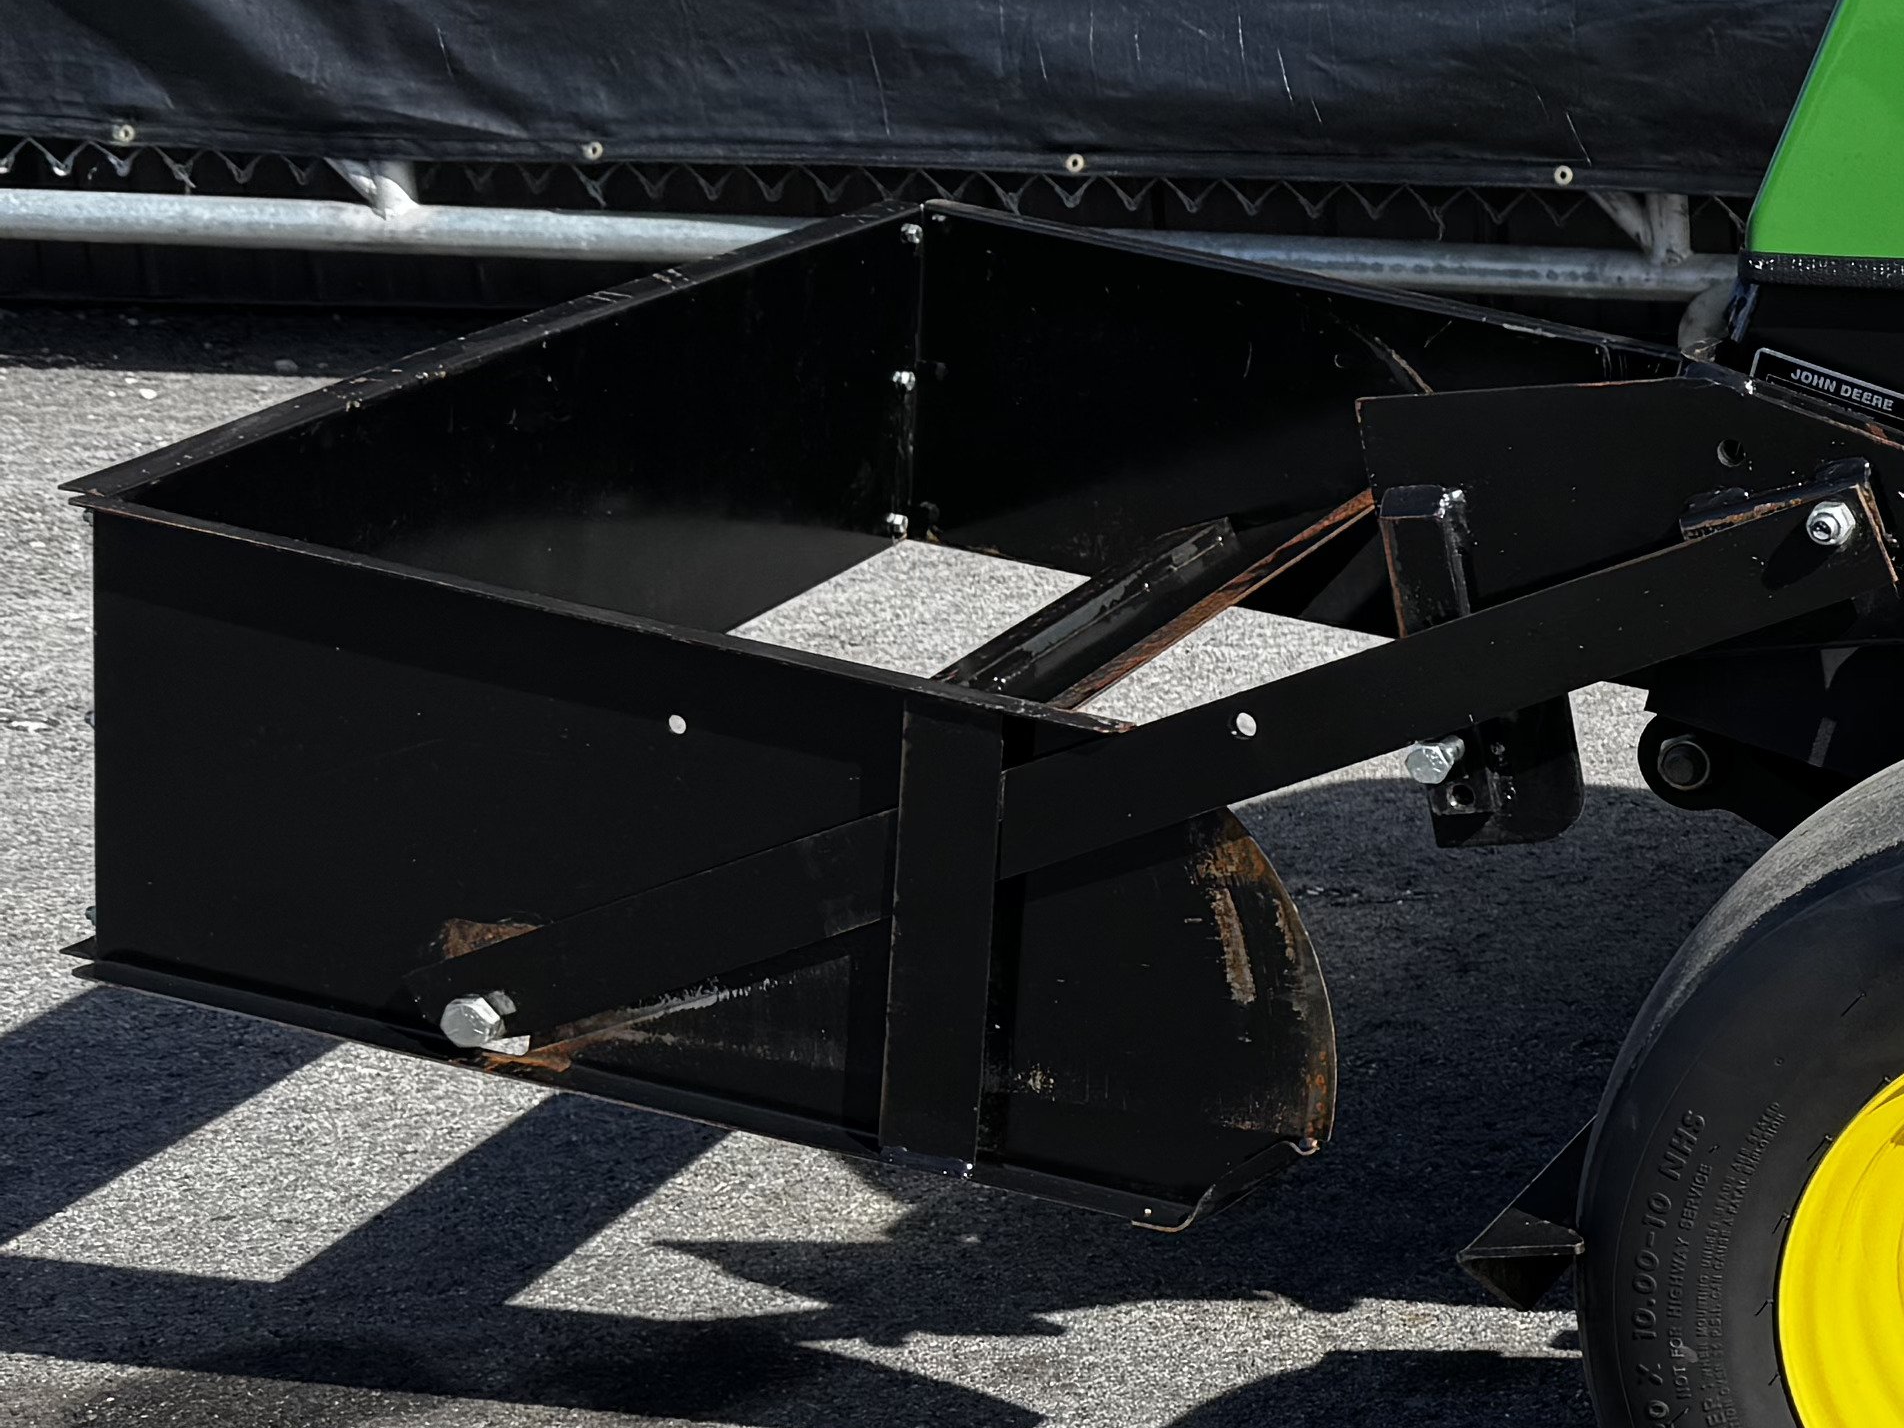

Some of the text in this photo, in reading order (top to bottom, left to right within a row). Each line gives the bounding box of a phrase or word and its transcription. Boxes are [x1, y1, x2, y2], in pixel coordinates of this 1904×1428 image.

[1790, 368, 1837, 393] JOHN
[1840, 384, 1895, 412] DEERE
[1630, 1190, 1674, 1341] 10.00-10
[1657, 1108, 1707, 1182] NHS
[1665, 1162, 1711, 1401] NOT FOR HIGHWAY SERVICE
